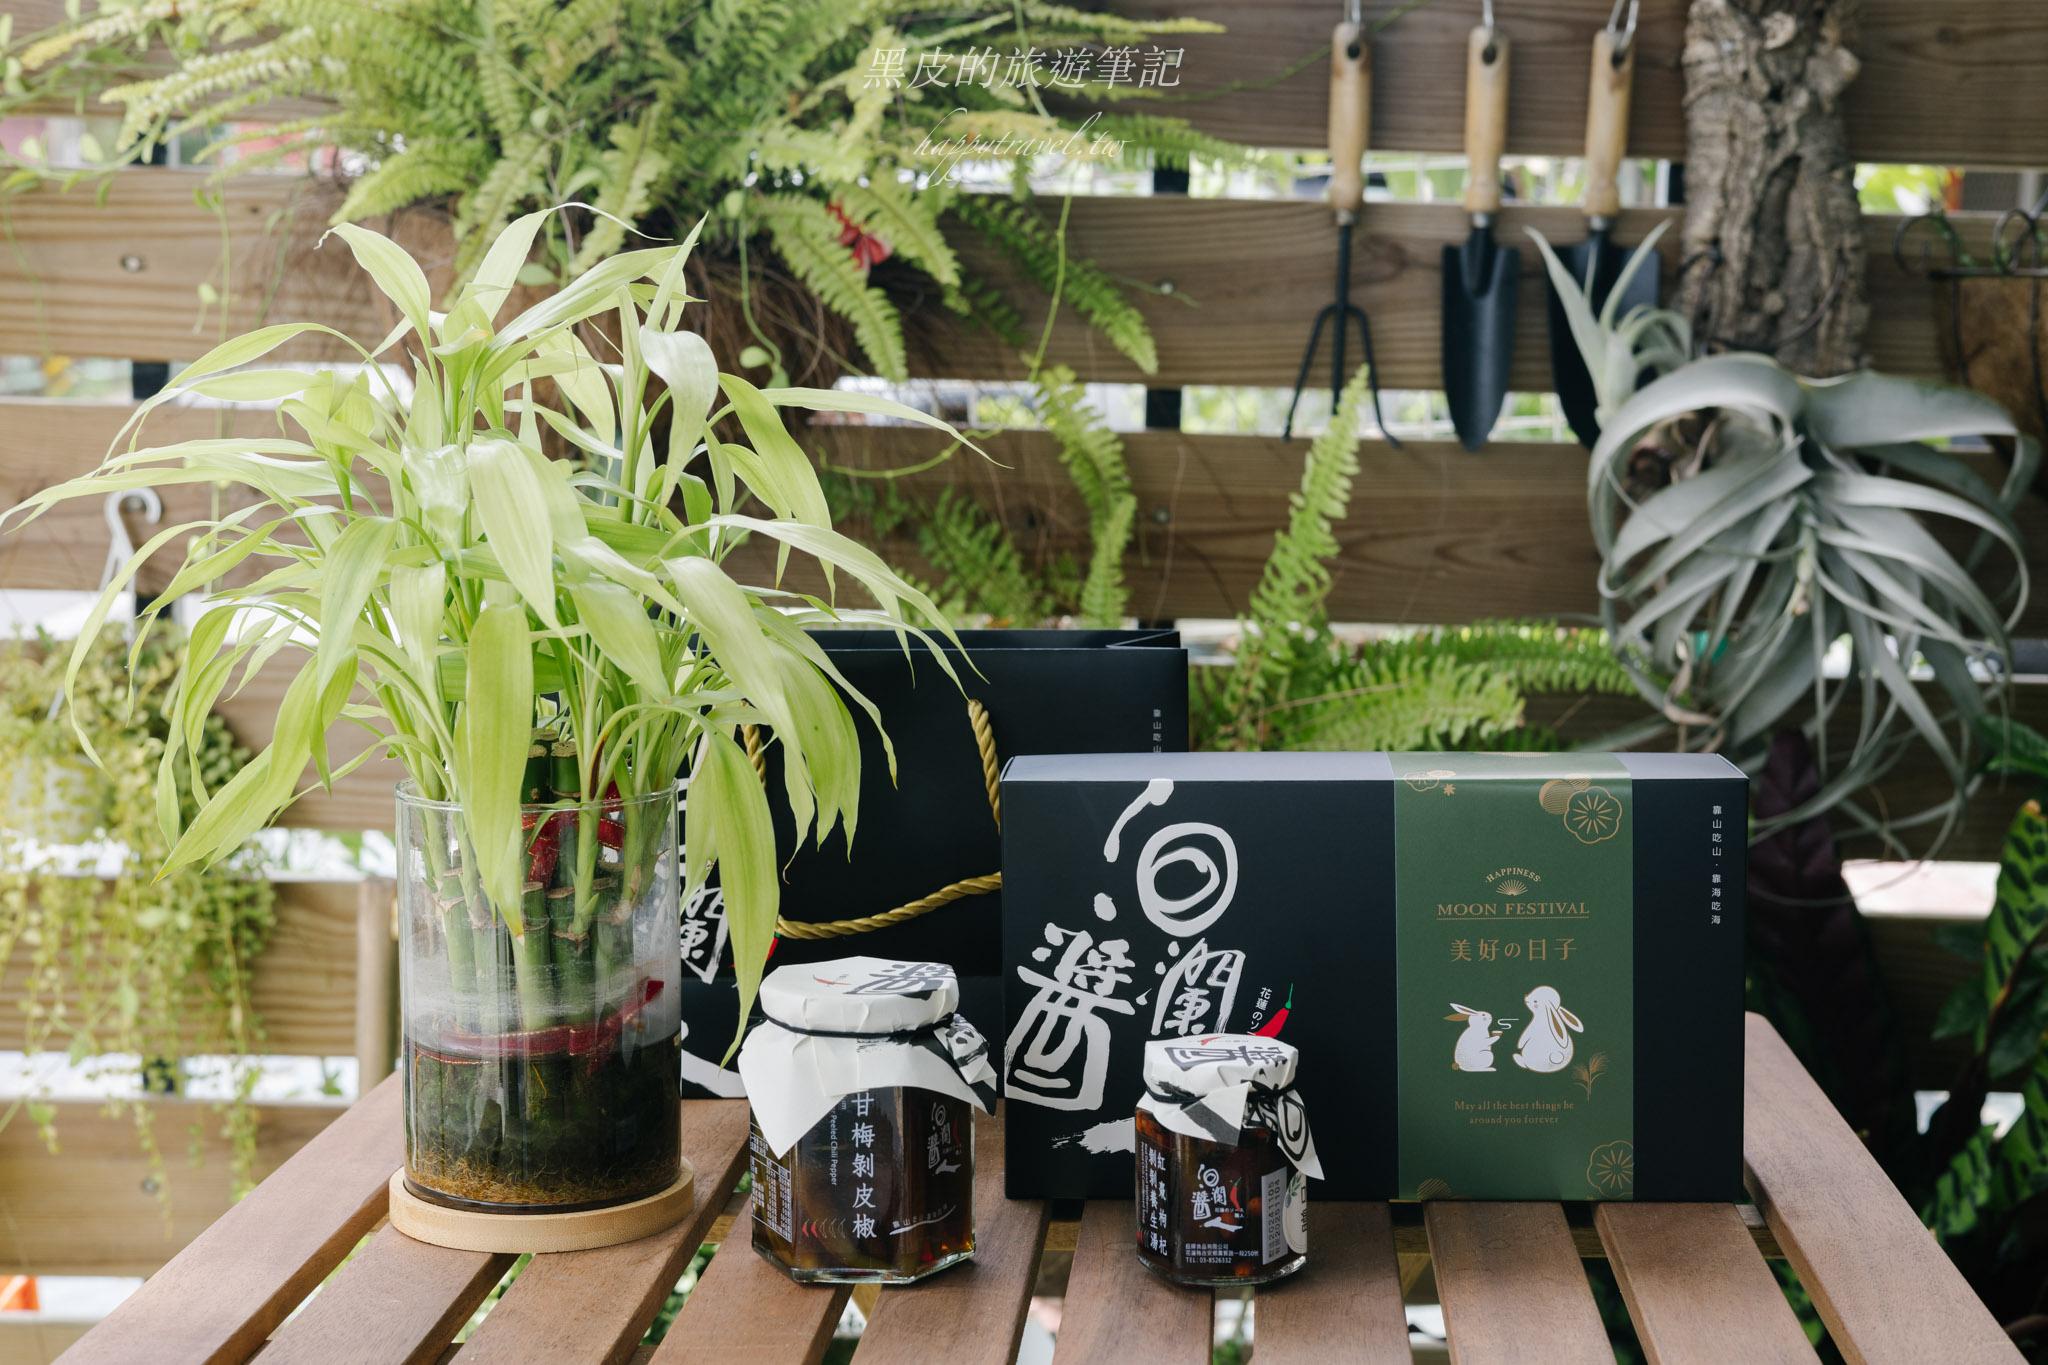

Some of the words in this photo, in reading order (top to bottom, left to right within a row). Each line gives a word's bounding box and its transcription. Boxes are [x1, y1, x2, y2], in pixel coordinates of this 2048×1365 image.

[1487, 867, 1541, 883] HAPPINESS
[1437, 902, 1497, 916] MOON
[1505, 902, 1590, 916] FESTIVAL
[1450, 938, 1577, 962] 美好の日子
[1455, 1100, 1475, 1113] May
[1478, 1100, 1490, 1111] all
[1493, 1101, 1505, 1110] the
[1510, 1100, 1529, 1110] best
[1531, 1099, 1560, 1112] things
[1563, 1100, 1575, 1110] be
[830, 1114, 838, 1139] Peeled
[1469, 1114, 1502, 1124] around
[1504, 1116, 1521, 1126] you
[1524, 1114, 1559, 1124] forever
[830, 1140, 838, 1158] Chili
[829, 1158, 838, 1186] Pepper
[851, 1091, 877, 1239] 甘梅剝皮椒
